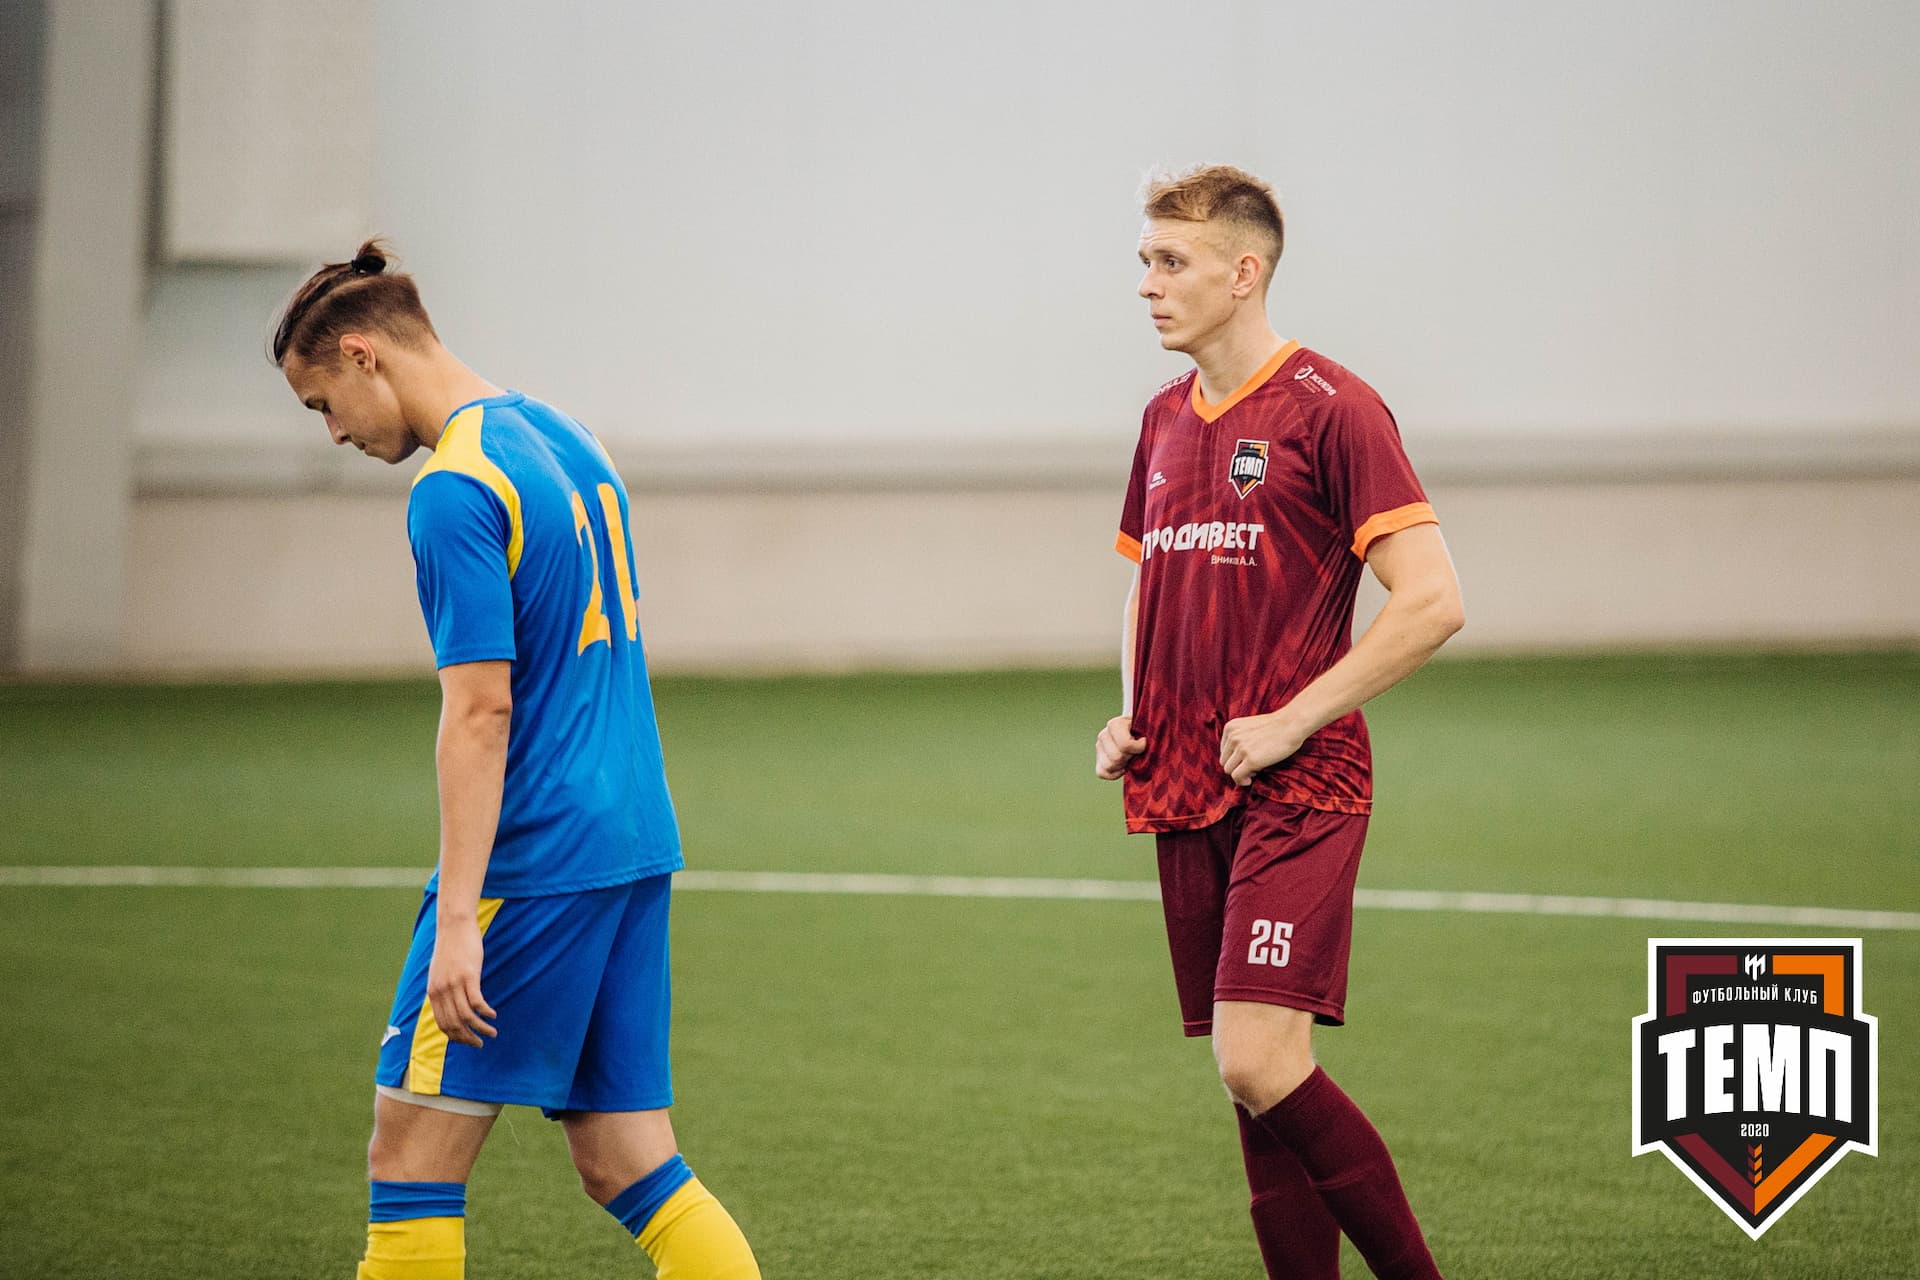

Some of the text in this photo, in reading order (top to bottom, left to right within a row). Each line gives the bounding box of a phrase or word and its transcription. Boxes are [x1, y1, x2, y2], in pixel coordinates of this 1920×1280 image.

[1233, 456, 1265, 478] ТЕМП
[1141, 521, 1264, 562] ПРОДИВЕСТ
[1247, 919, 1294, 968] 25
